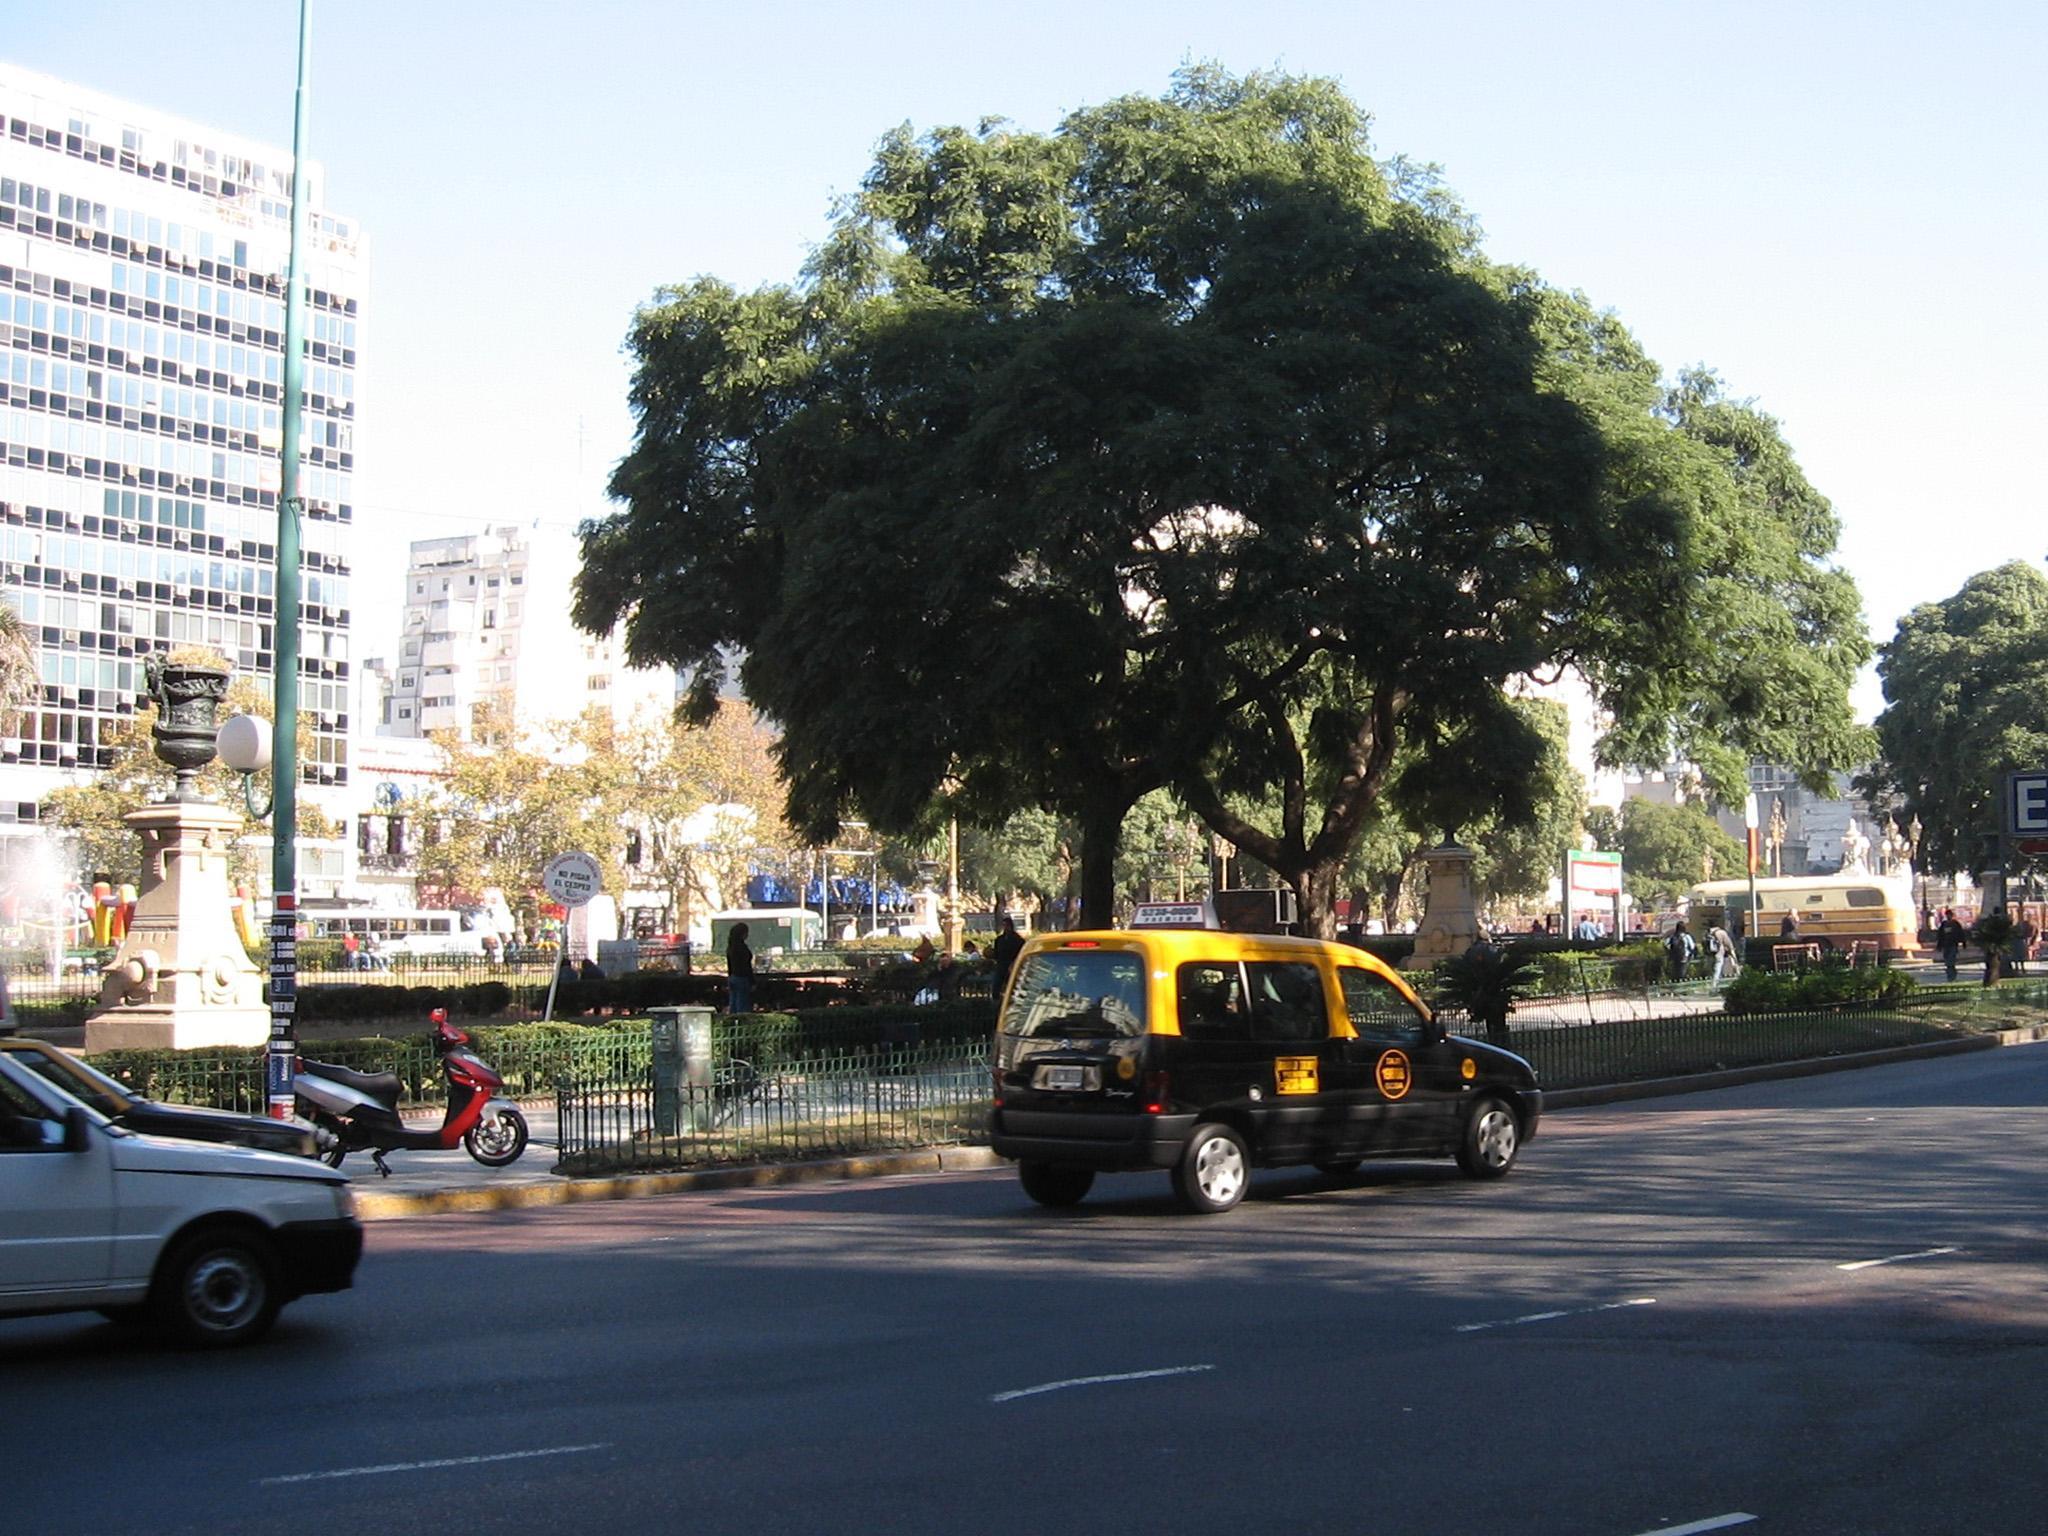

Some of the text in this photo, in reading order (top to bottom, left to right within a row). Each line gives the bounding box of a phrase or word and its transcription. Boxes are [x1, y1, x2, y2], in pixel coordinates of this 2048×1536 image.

[2017, 779, 2047, 829] E
[569, 872, 590, 881] PISAR
[554, 879, 591, 891] EL CESPED
